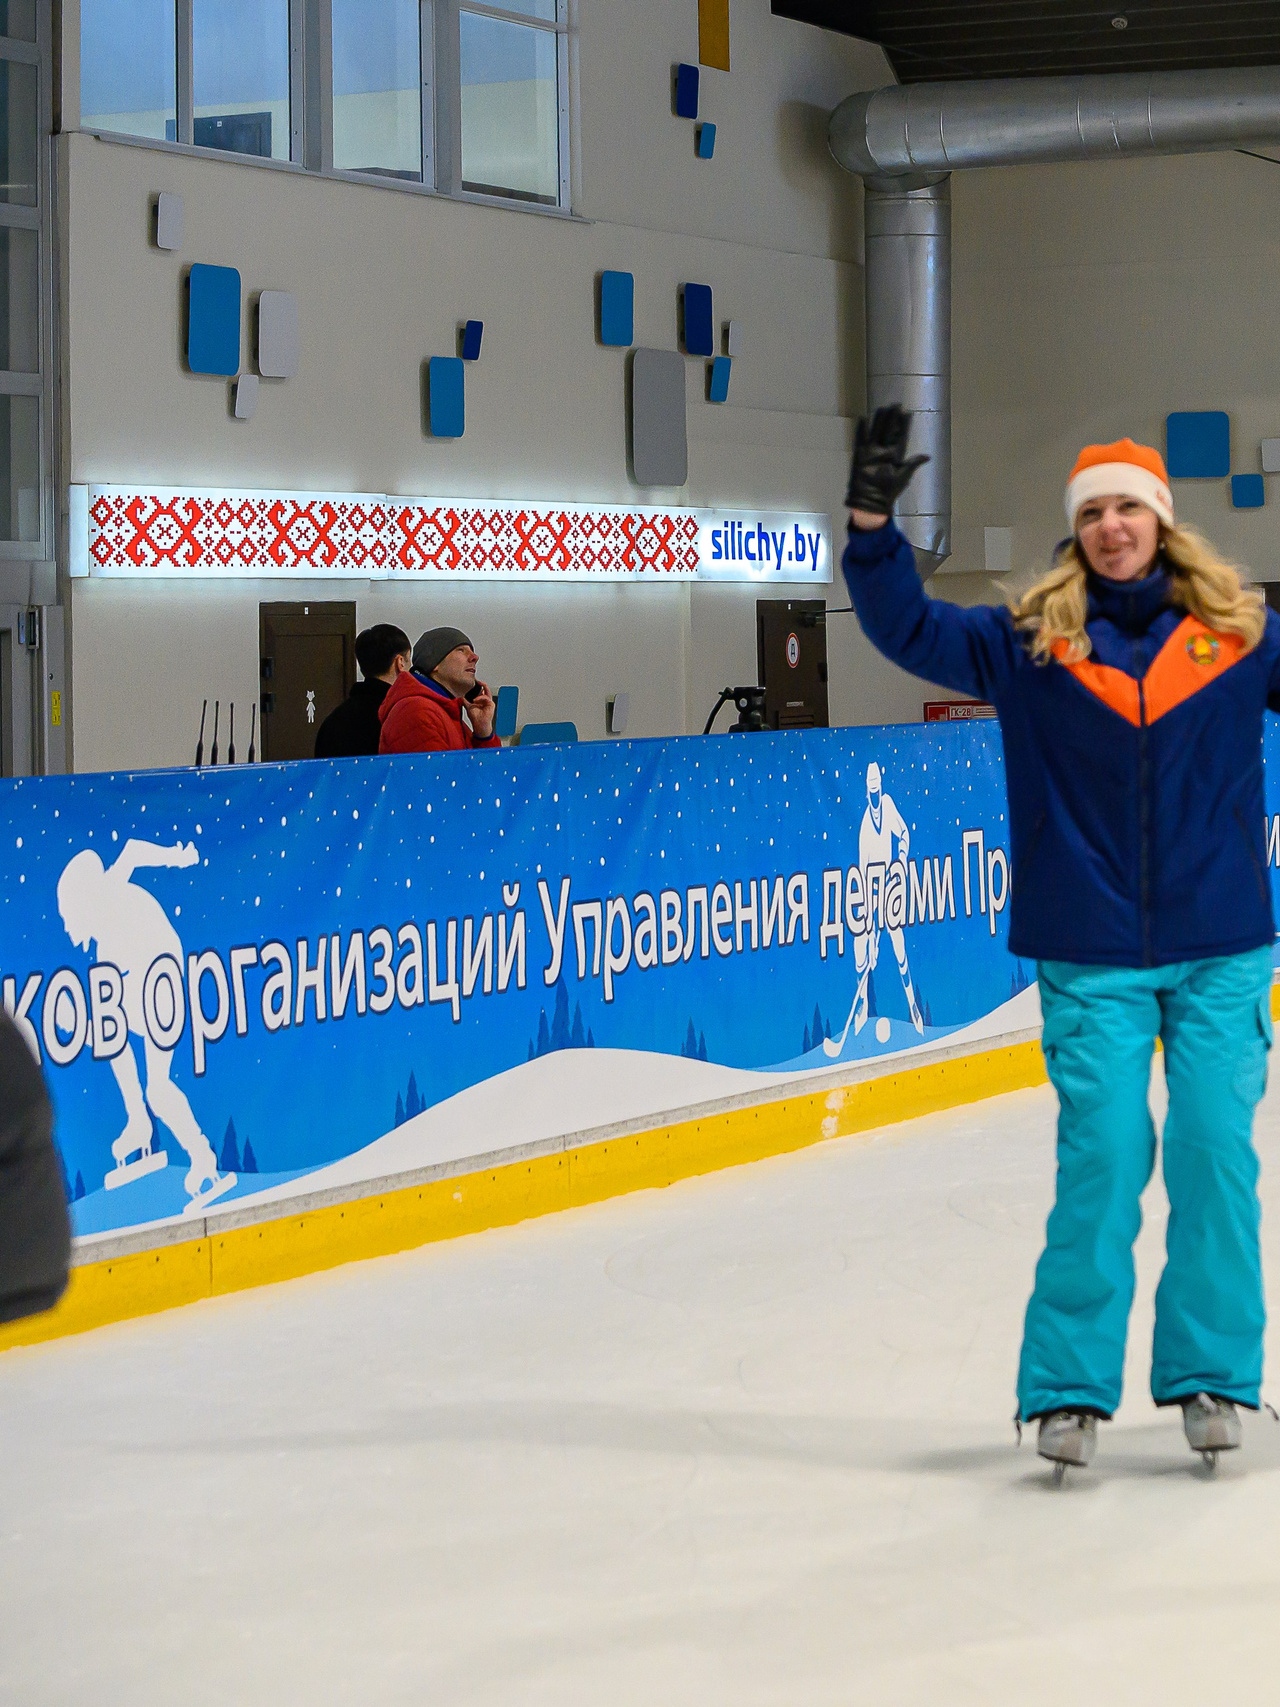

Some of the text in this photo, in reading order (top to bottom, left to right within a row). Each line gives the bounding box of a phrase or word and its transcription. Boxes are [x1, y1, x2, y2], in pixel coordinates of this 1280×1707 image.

[711, 520, 821, 571] silichy.by
[3, 960, 129, 1067] ков
[143, 881, 527, 1077] организаций
[536, 874, 810, 1003] Управления
[819, 853, 956, 960] делами
[962, 828, 1013, 937] Пр
